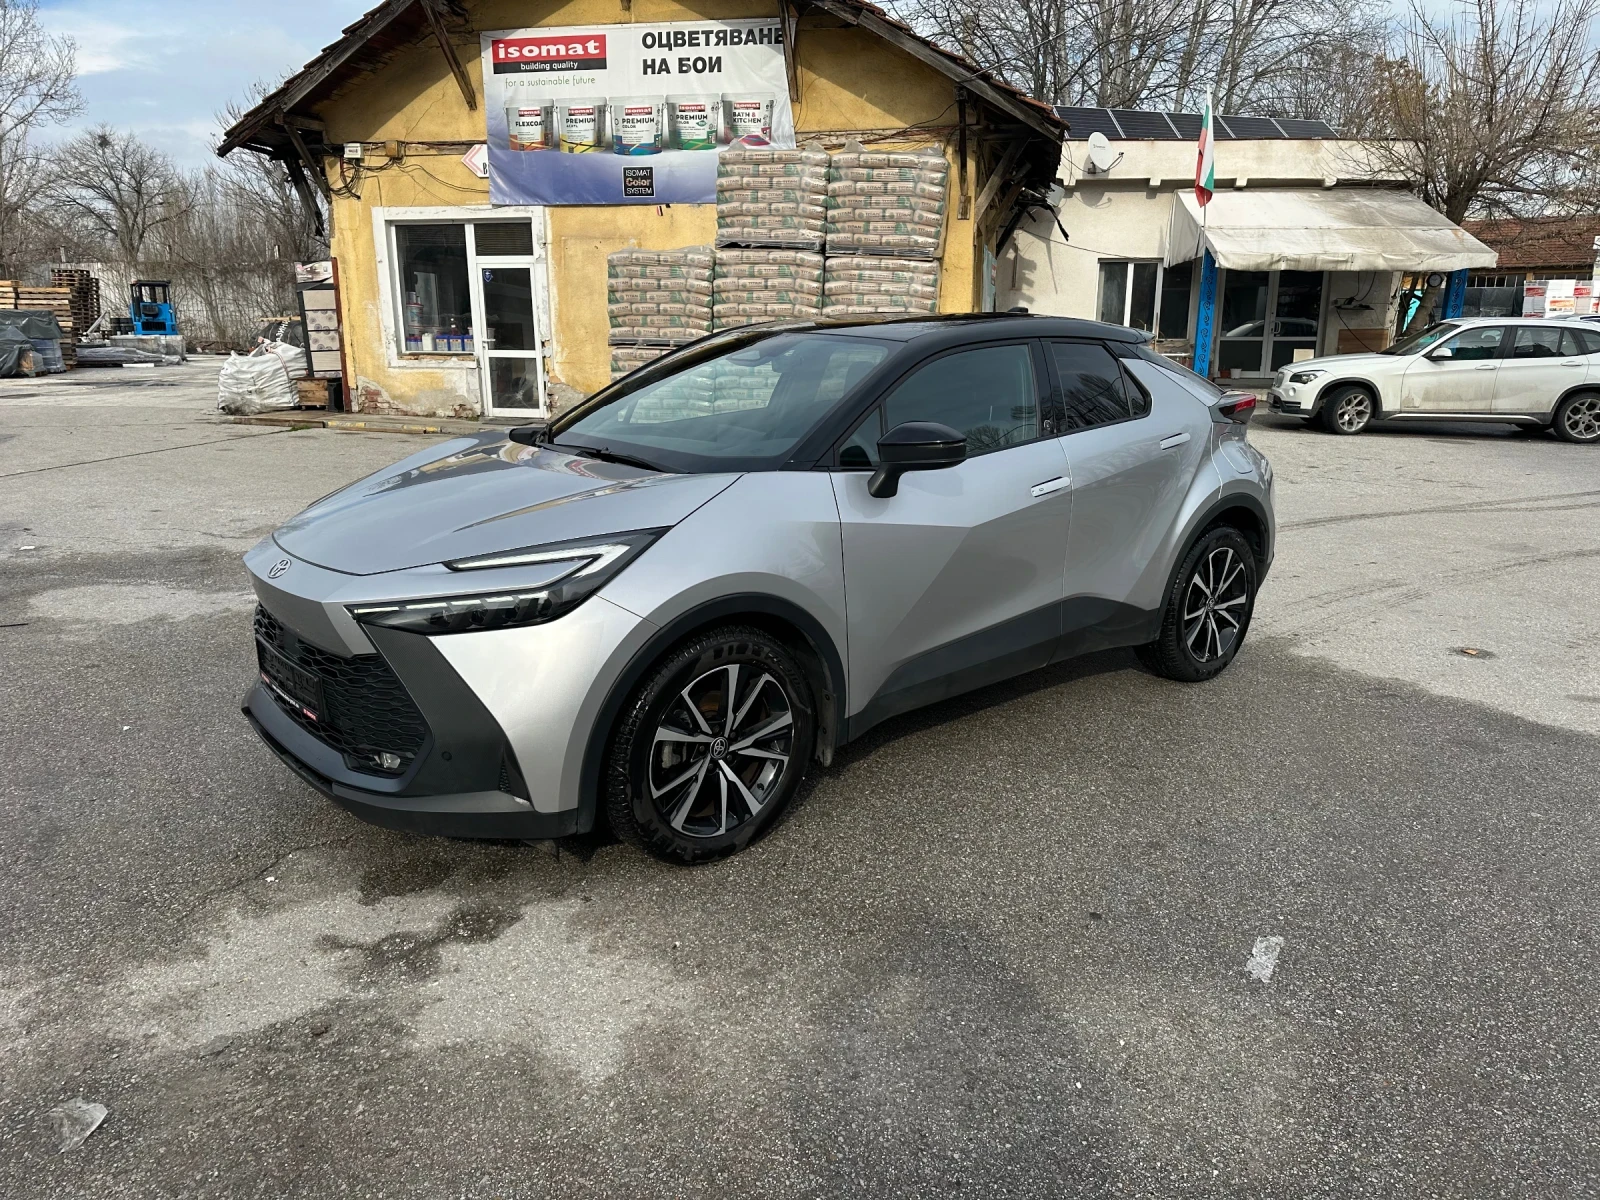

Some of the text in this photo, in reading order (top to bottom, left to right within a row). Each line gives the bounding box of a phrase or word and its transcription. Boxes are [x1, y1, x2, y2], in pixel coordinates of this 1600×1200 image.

[498, 40, 599, 59] isomat
[520, 60, 578, 71] building quality
[643, 56, 721, 74] НА БОИ
[505, 78, 516, 89] for
[528, 76, 570, 87] sustainable
[572, 75, 596, 86] future
[626, 178, 652, 186] Color
